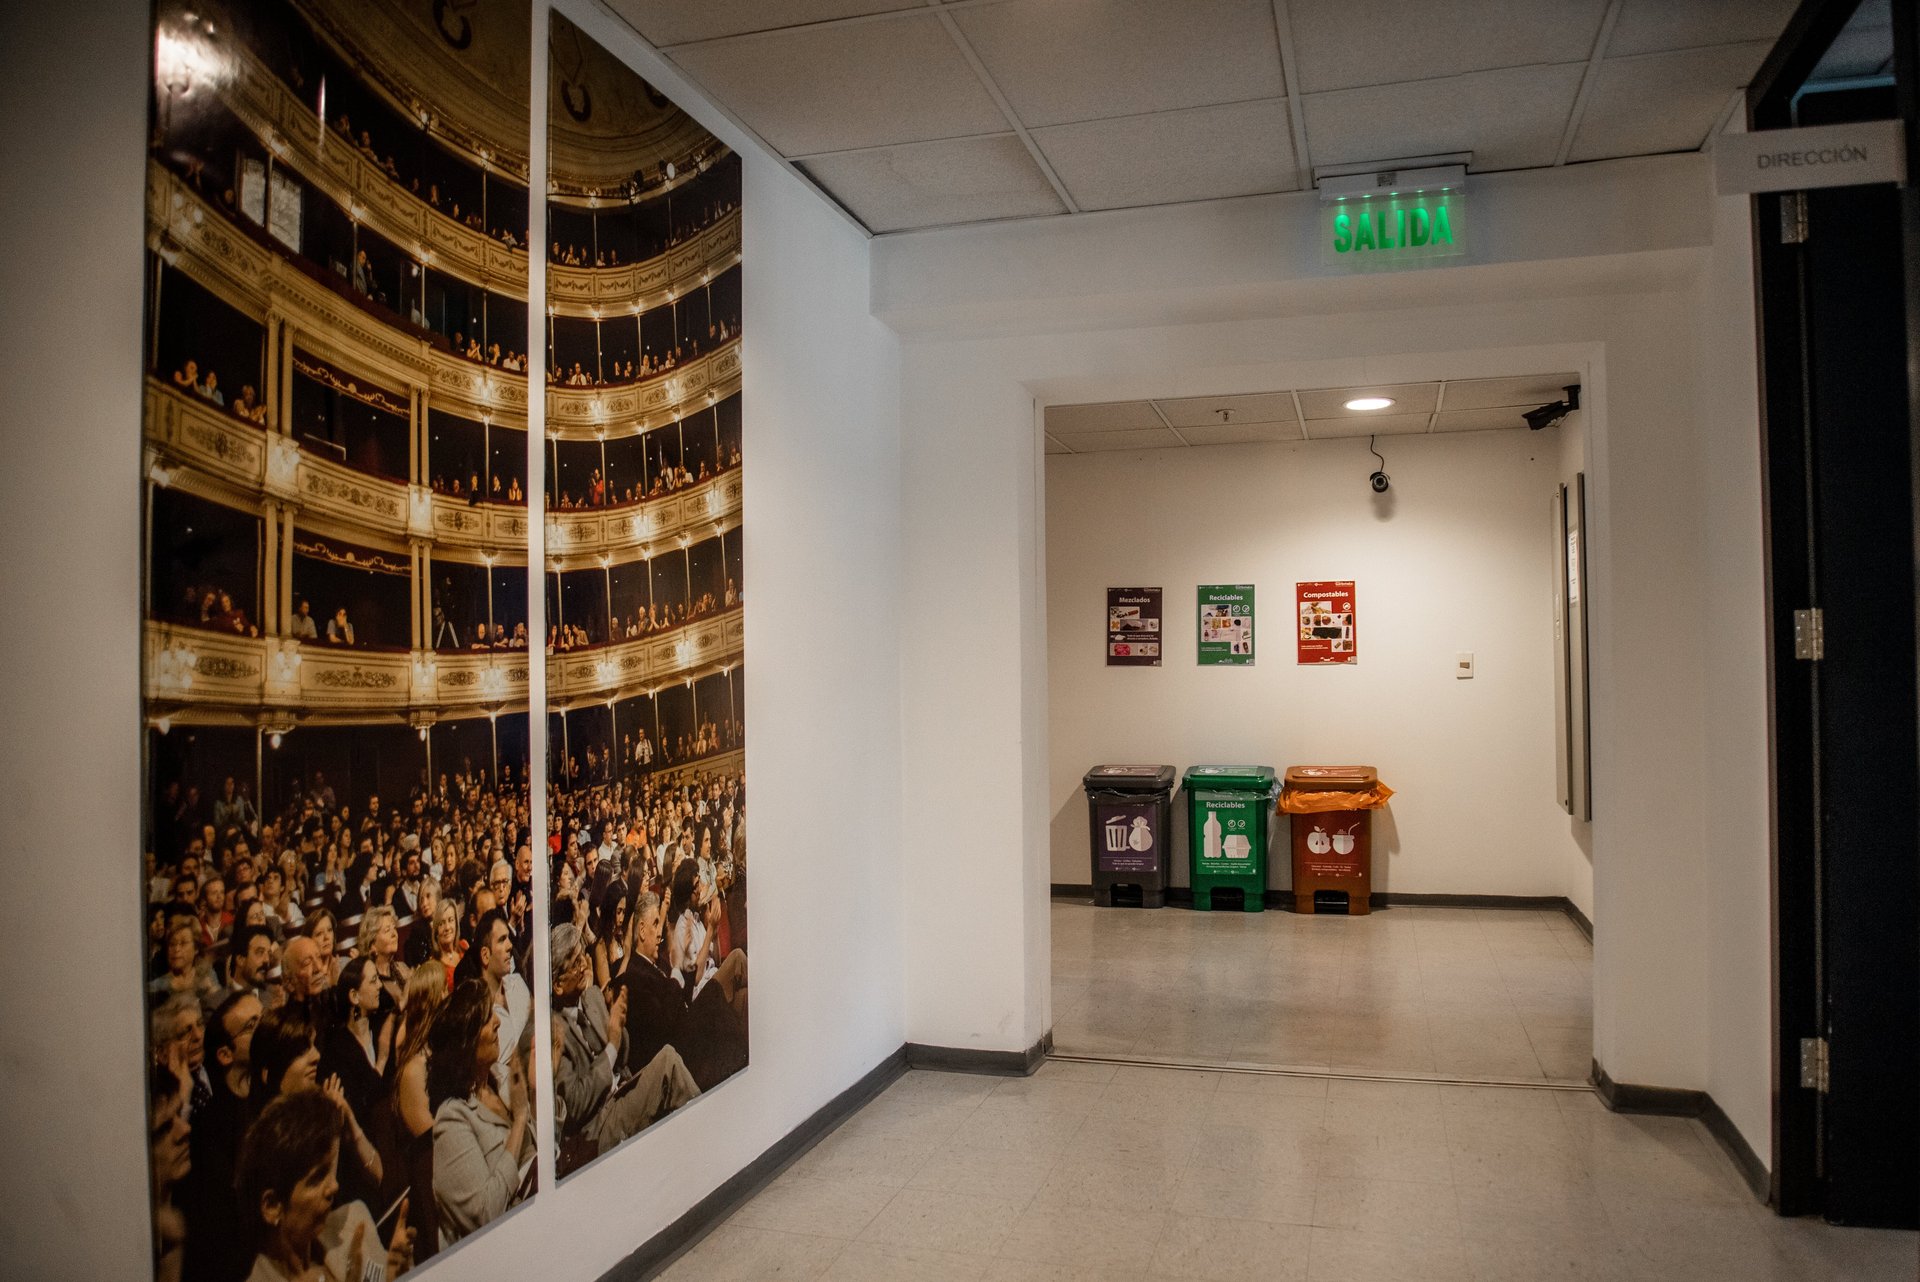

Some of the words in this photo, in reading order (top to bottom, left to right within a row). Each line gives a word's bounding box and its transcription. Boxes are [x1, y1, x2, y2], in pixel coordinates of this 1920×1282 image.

[1757, 144, 1868, 169] DIRECCIÓN
[1334, 205, 1454, 253] SALIDA
[1303, 591, 1349, 599] Compostables
[1206, 801, 1245, 809] Reciclables
